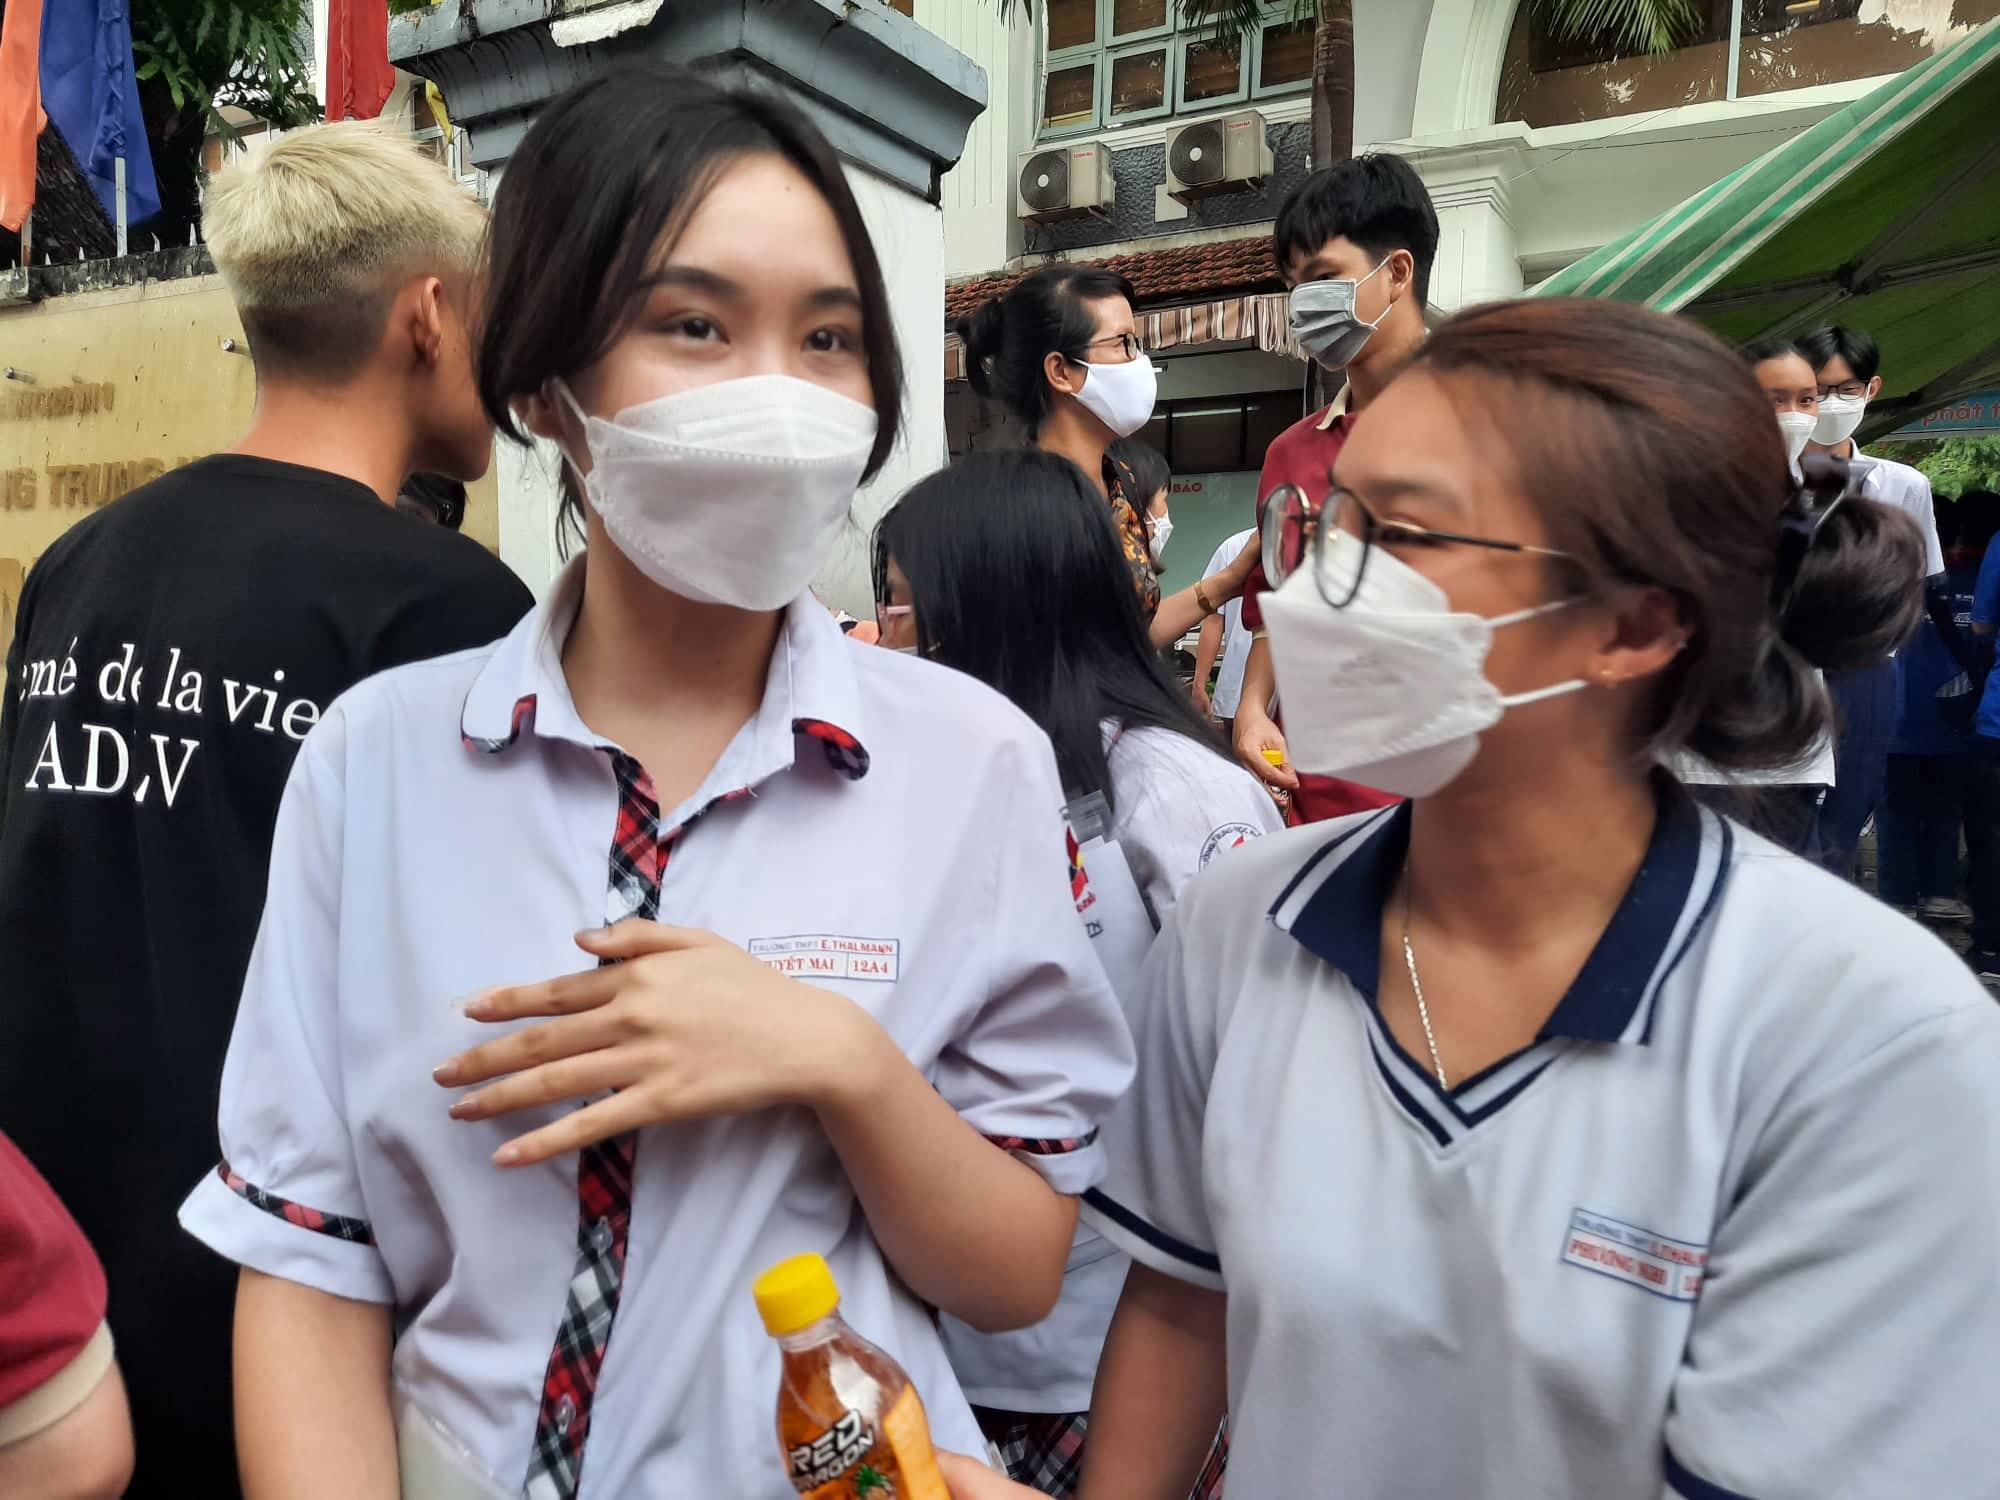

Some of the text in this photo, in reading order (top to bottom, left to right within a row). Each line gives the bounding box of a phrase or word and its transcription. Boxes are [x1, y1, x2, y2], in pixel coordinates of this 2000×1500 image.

[157, 648, 203, 713] la
[223, 669, 321, 741] vie
[24, 720, 200, 809] ADV
[762, 955, 888, 974] UYẾT MAI 12A4
[789, 1408, 862, 1473] RED
